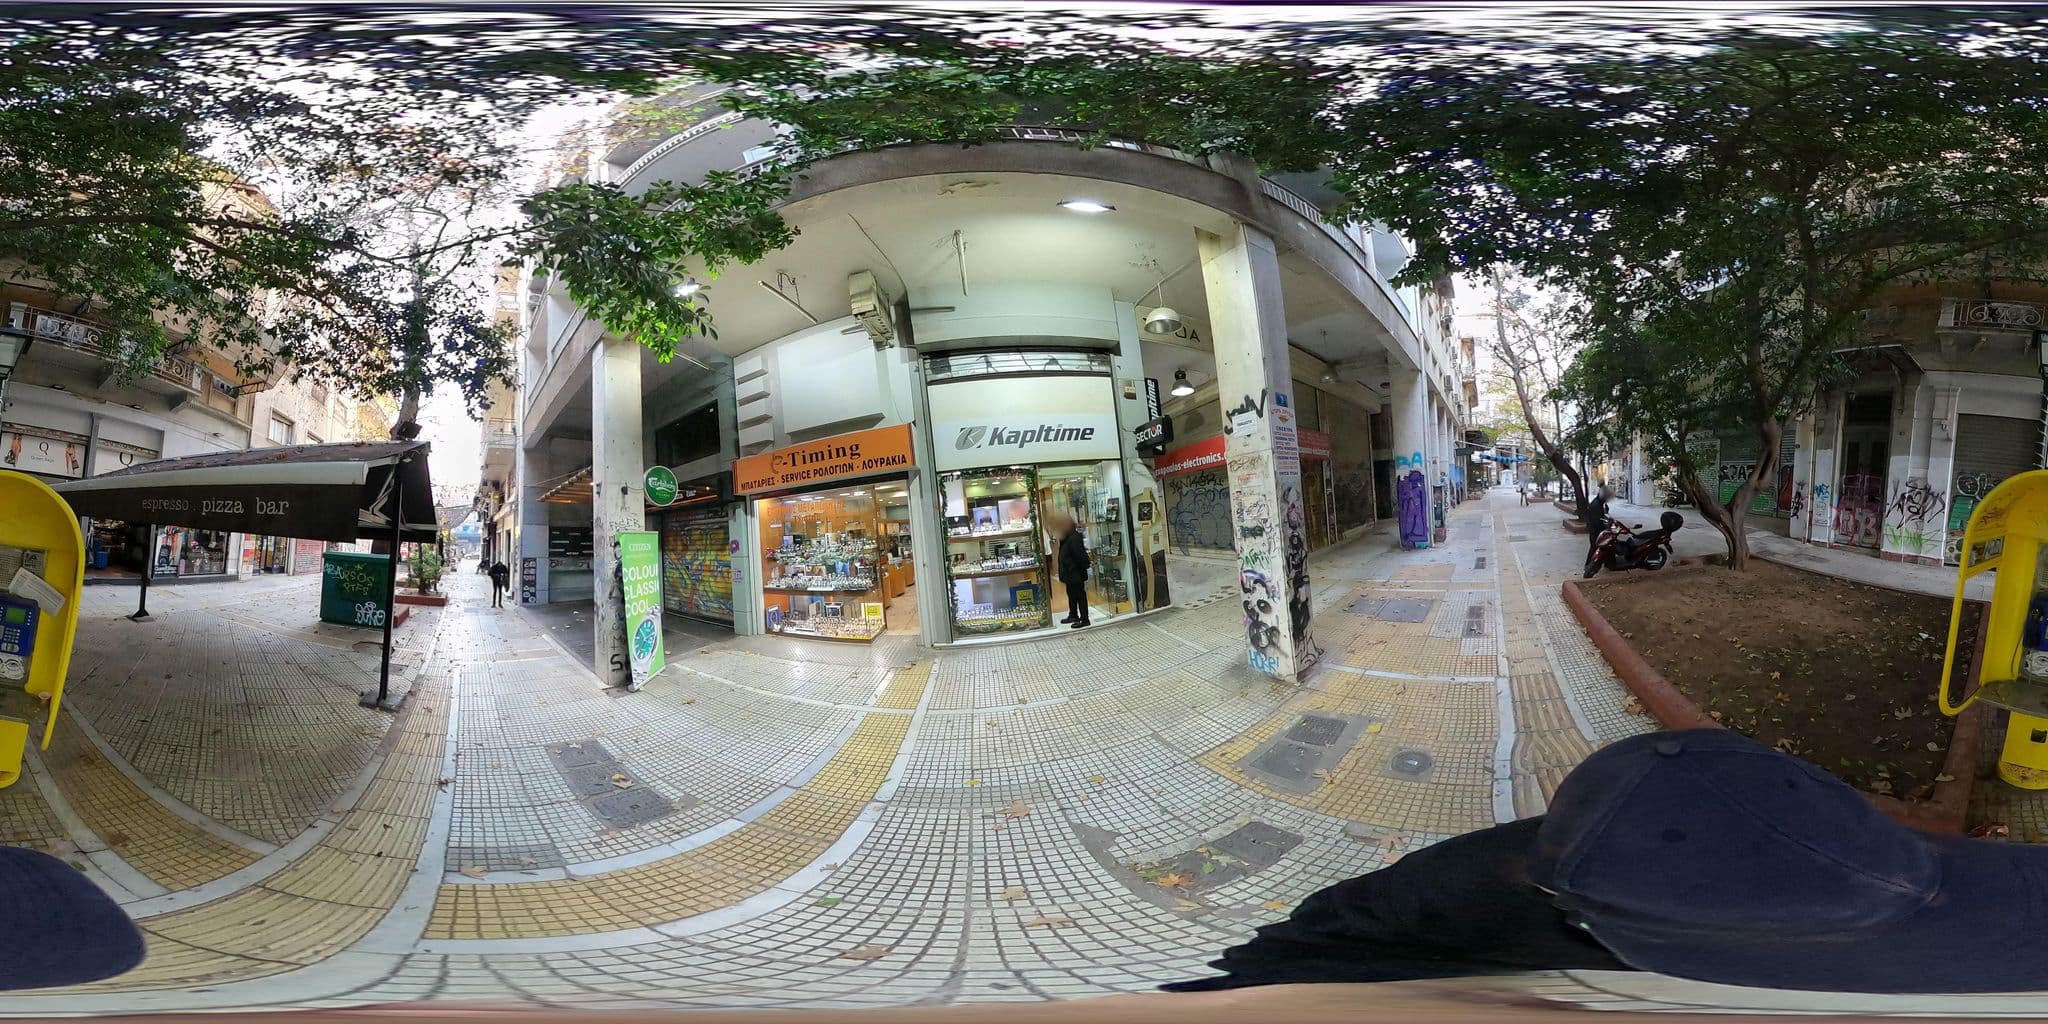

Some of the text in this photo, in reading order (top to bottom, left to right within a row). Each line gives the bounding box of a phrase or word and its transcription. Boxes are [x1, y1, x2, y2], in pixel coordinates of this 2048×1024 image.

[988, 423, 1095, 448] Kapltime
[1136, 424, 1163, 443] SECTOR
[39, 441, 49, 455] Q
[741, 454, 907, 491] ΜΠΑΤΑΡΙΕΣ SERVICE ΡΟΛΟΓΙΩΝ ΛΟΥΡΑΚΙΑ
[142, 496, 289, 515] espresso pizza bar
